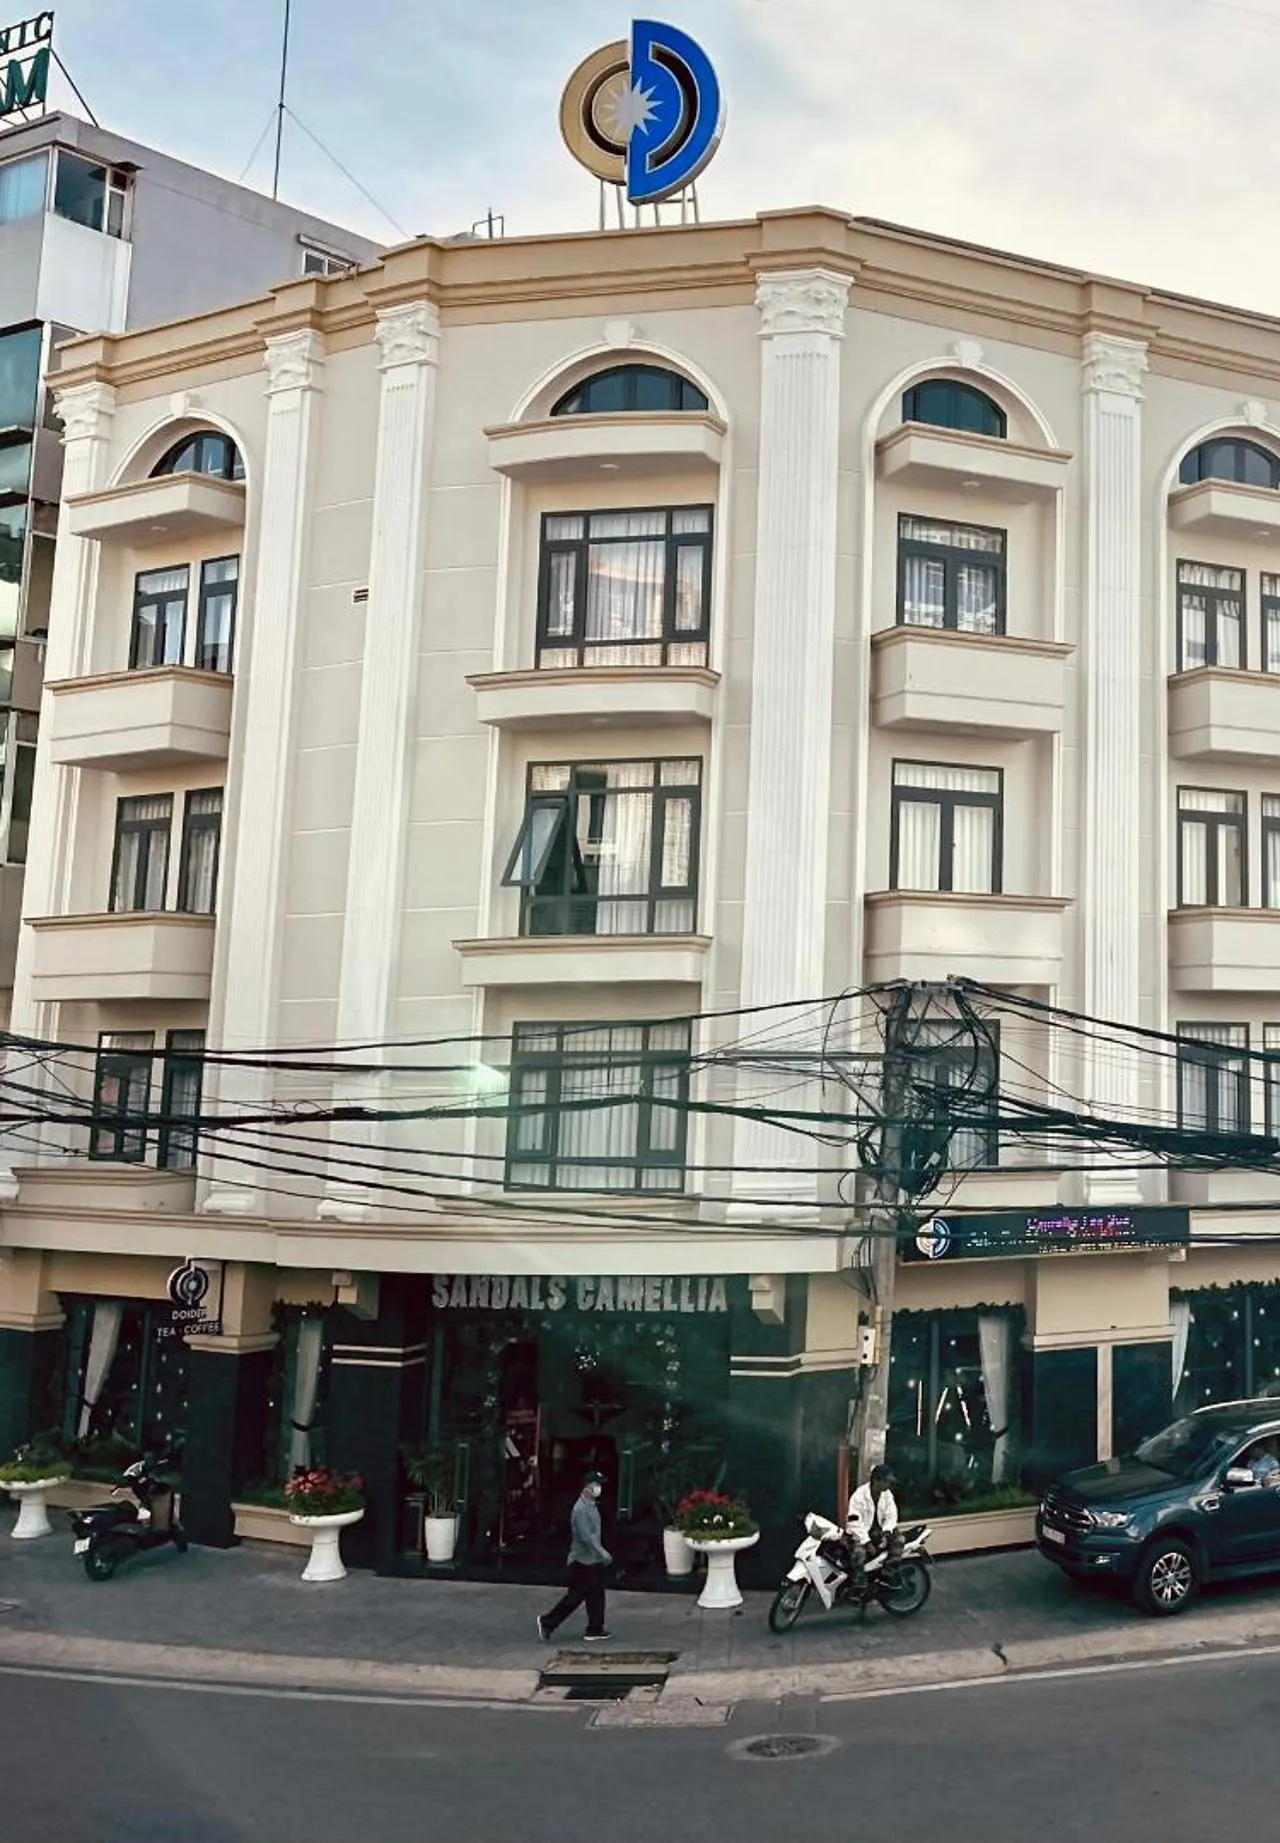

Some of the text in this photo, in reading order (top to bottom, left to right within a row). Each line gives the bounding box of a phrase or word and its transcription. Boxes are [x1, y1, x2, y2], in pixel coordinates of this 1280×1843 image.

[432, 1275, 728, 1312] SANDALS CAMELLIA
[157, 1321, 220, 1337] TEA COFFEE
